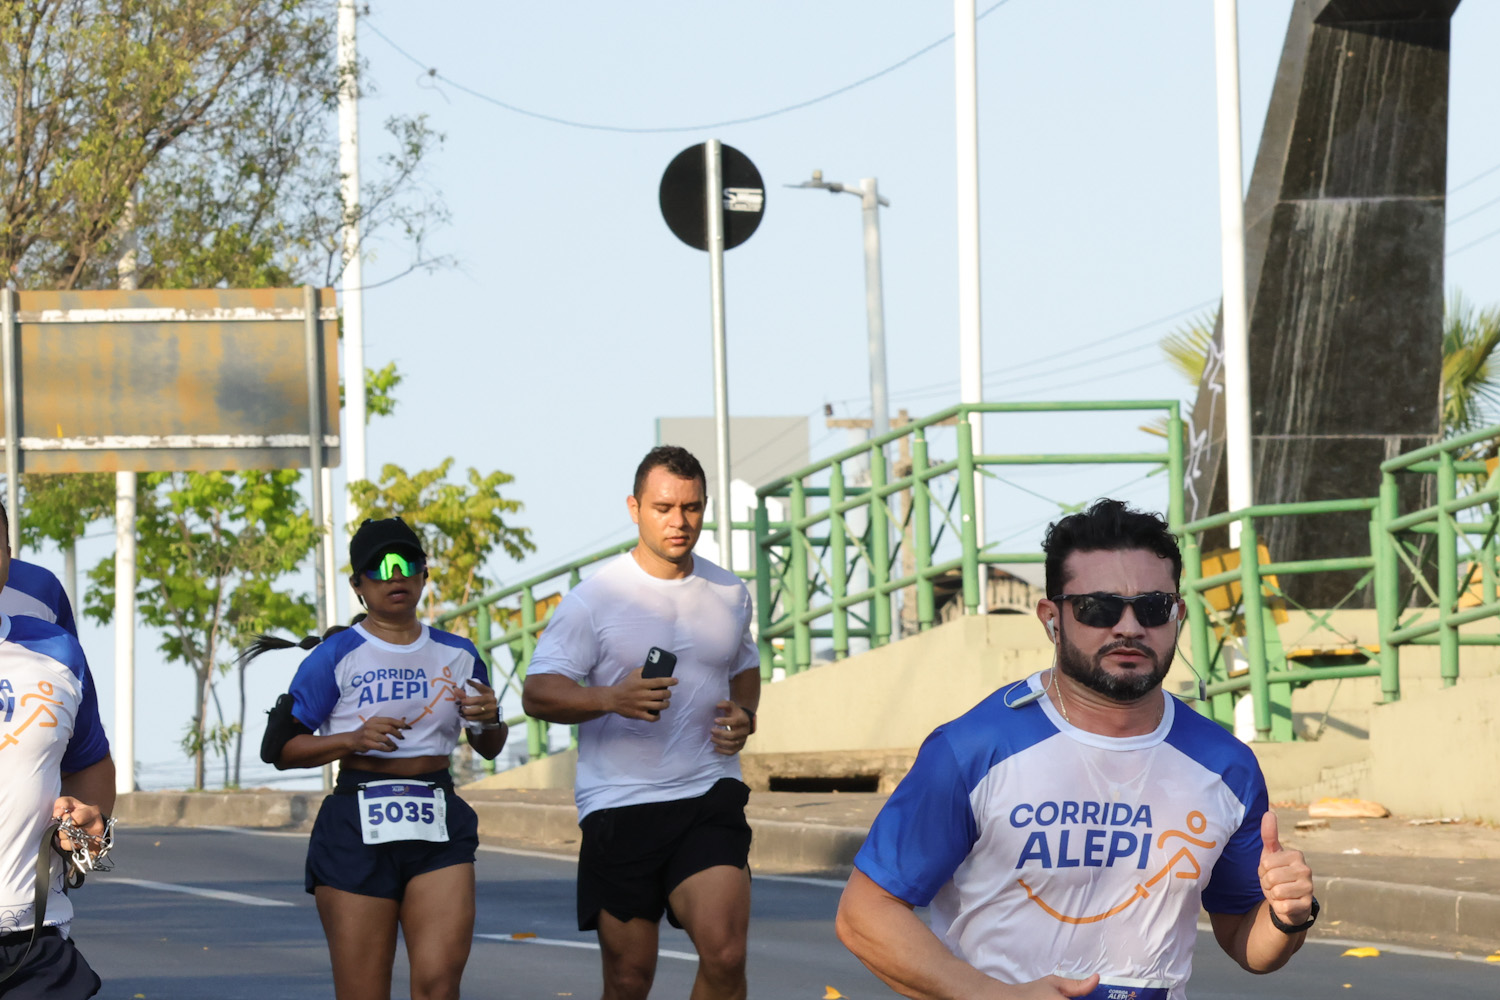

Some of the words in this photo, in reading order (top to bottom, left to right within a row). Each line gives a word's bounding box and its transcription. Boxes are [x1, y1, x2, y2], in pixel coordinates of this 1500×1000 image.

[351, 668, 427, 689] CORRIDA
[357, 681, 428, 709] ALEPI
[368, 801, 435, 825] 5035
[1009, 801, 1153, 828] CORRIDA
[1015, 829, 1152, 870] ALEPI
